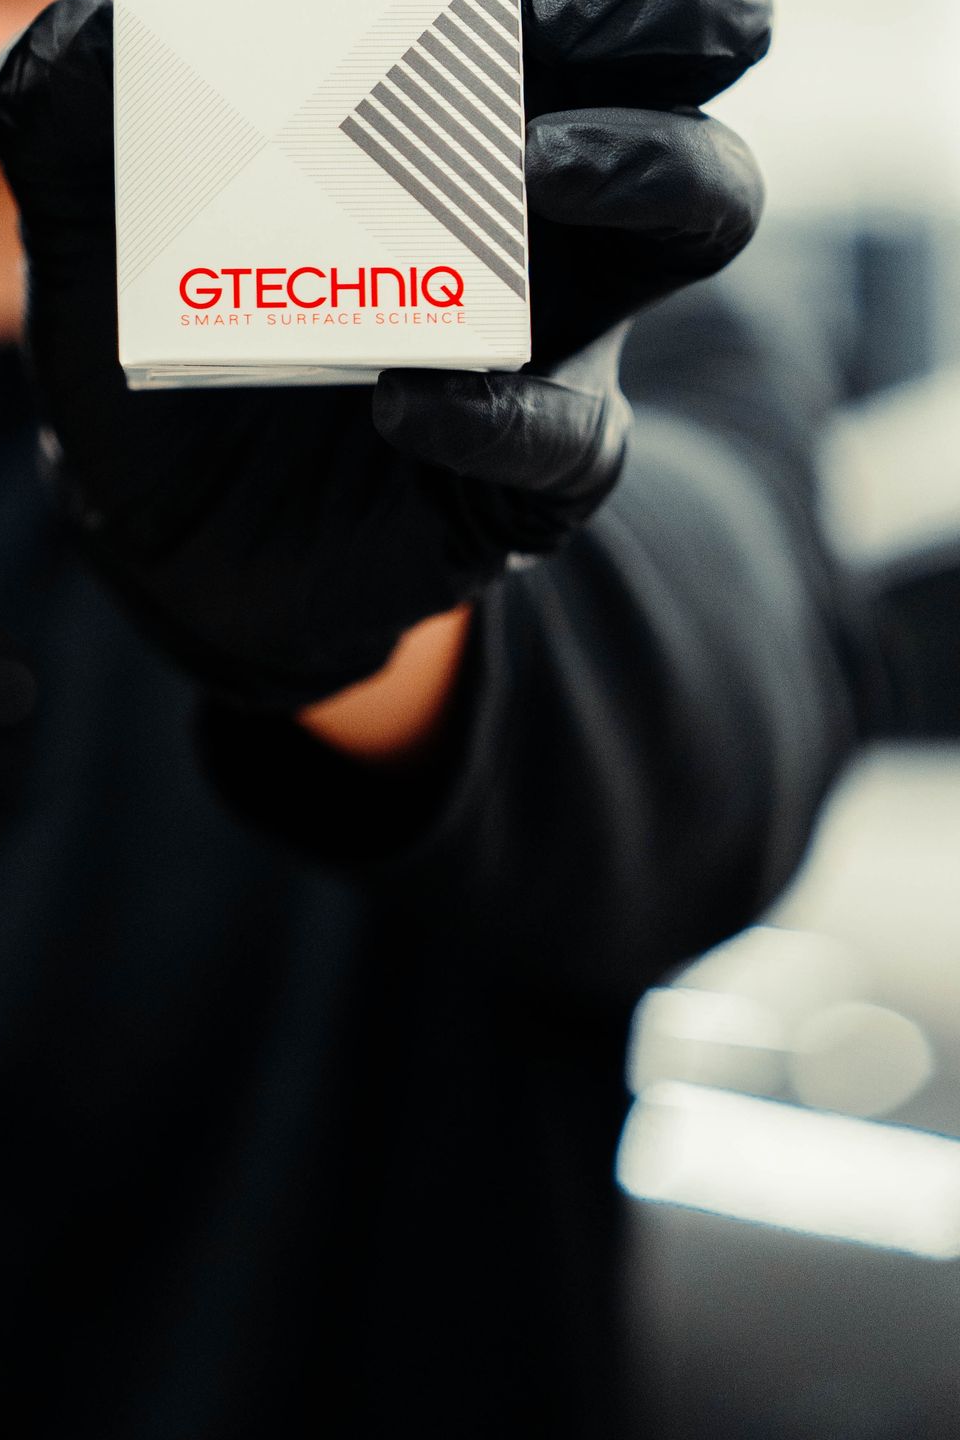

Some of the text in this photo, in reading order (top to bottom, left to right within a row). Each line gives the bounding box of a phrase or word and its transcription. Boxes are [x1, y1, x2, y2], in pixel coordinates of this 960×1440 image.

[179, 265, 465, 309] GTECHNIQ
[180, 311, 467, 327] SMART SURFACE SCIENCE
